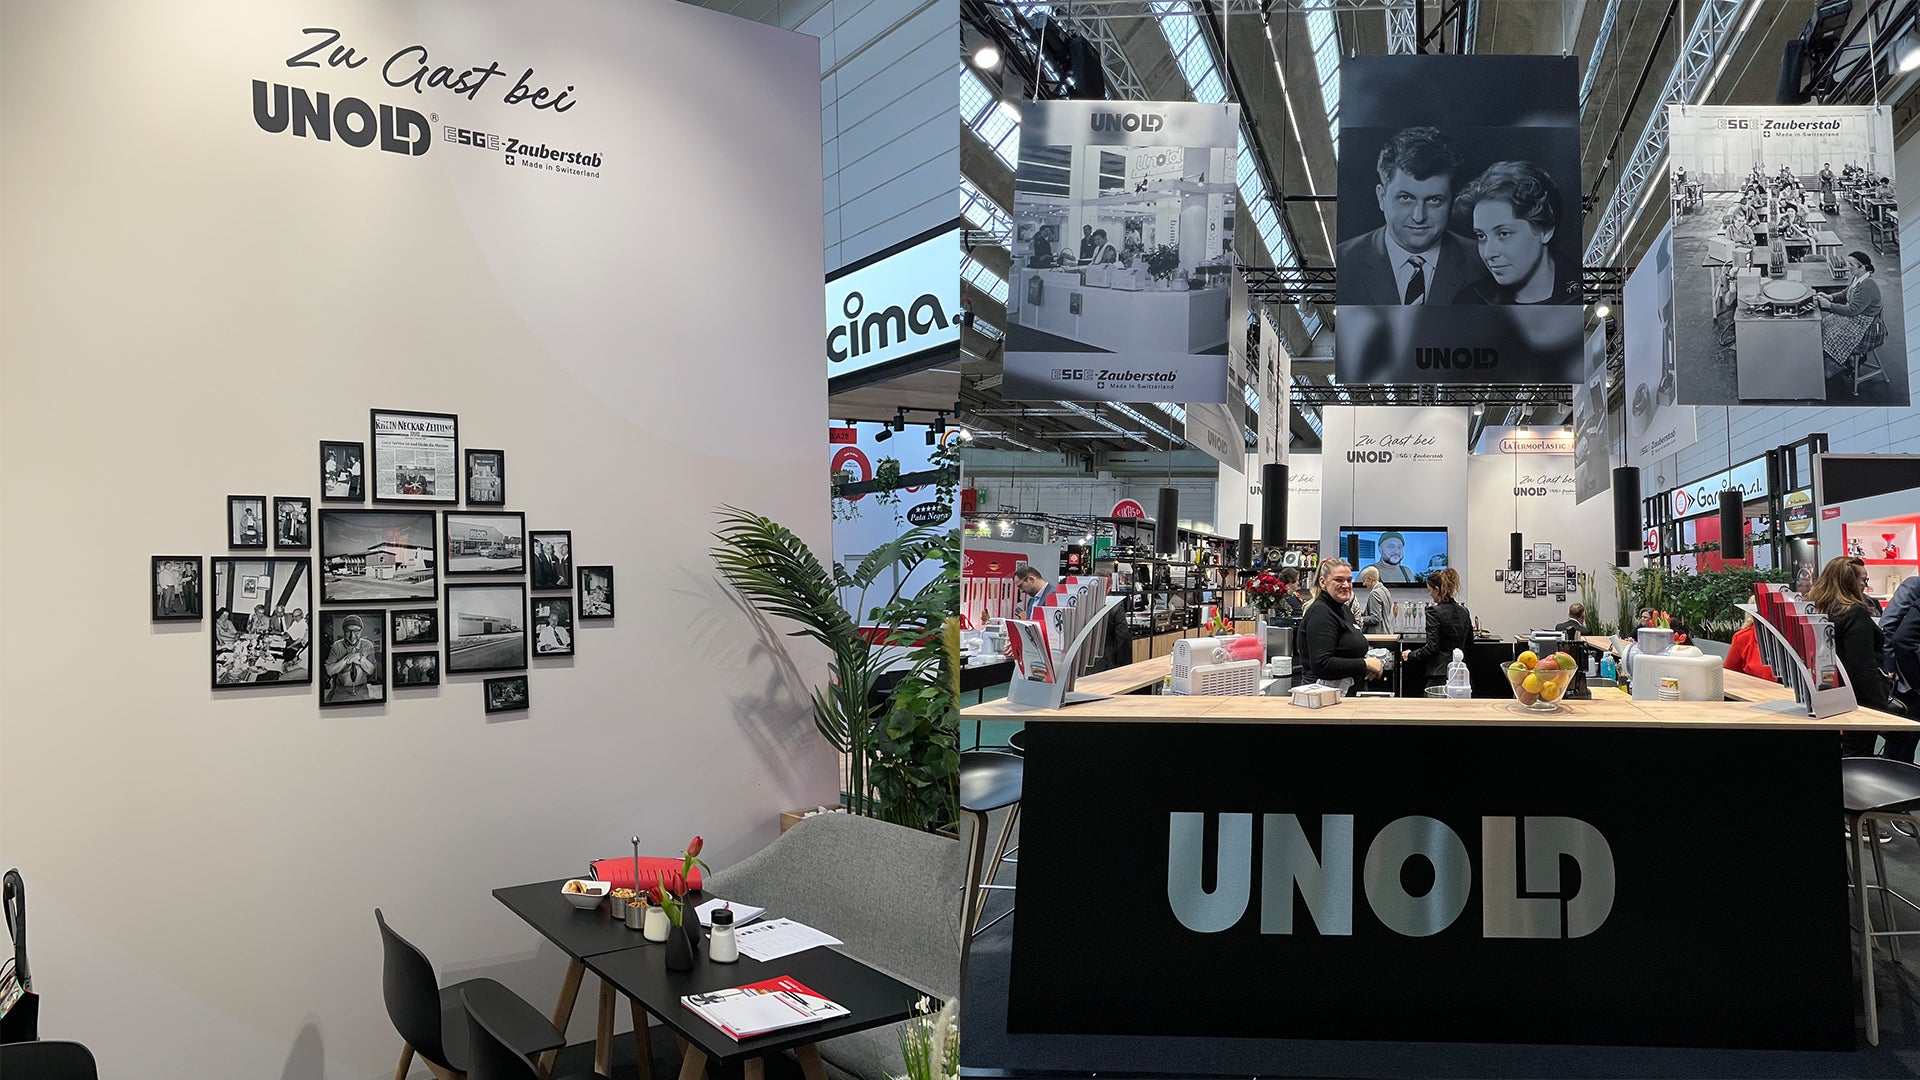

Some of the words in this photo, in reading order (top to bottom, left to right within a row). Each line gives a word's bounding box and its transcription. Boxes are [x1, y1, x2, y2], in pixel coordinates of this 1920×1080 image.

[286, 27, 367, 69] Zu
[382, 45, 507, 100] Gast
[503, 68, 577, 113] bei
[1090, 113, 1163, 132] UNOLD
[522, 159, 543, 170] Made
[545, 163, 553, 171] in
[556, 165, 600, 179] Switzerland
[1416, 348, 1499, 370] UNOLD
[1355, 434, 1376, 447] Zu
[1380, 434, 1414, 448] Gast
[1413, 433, 1436, 446] bei
[1346, 451, 1393, 463] UNOLD
[1537, 474, 1562, 486] Gast
[1513, 487, 1547, 496] UNOLD
[910, 513, 926, 521] Pata
[928, 512, 949, 521] Negra
[1167, 811, 1616, 939] UNOLD
